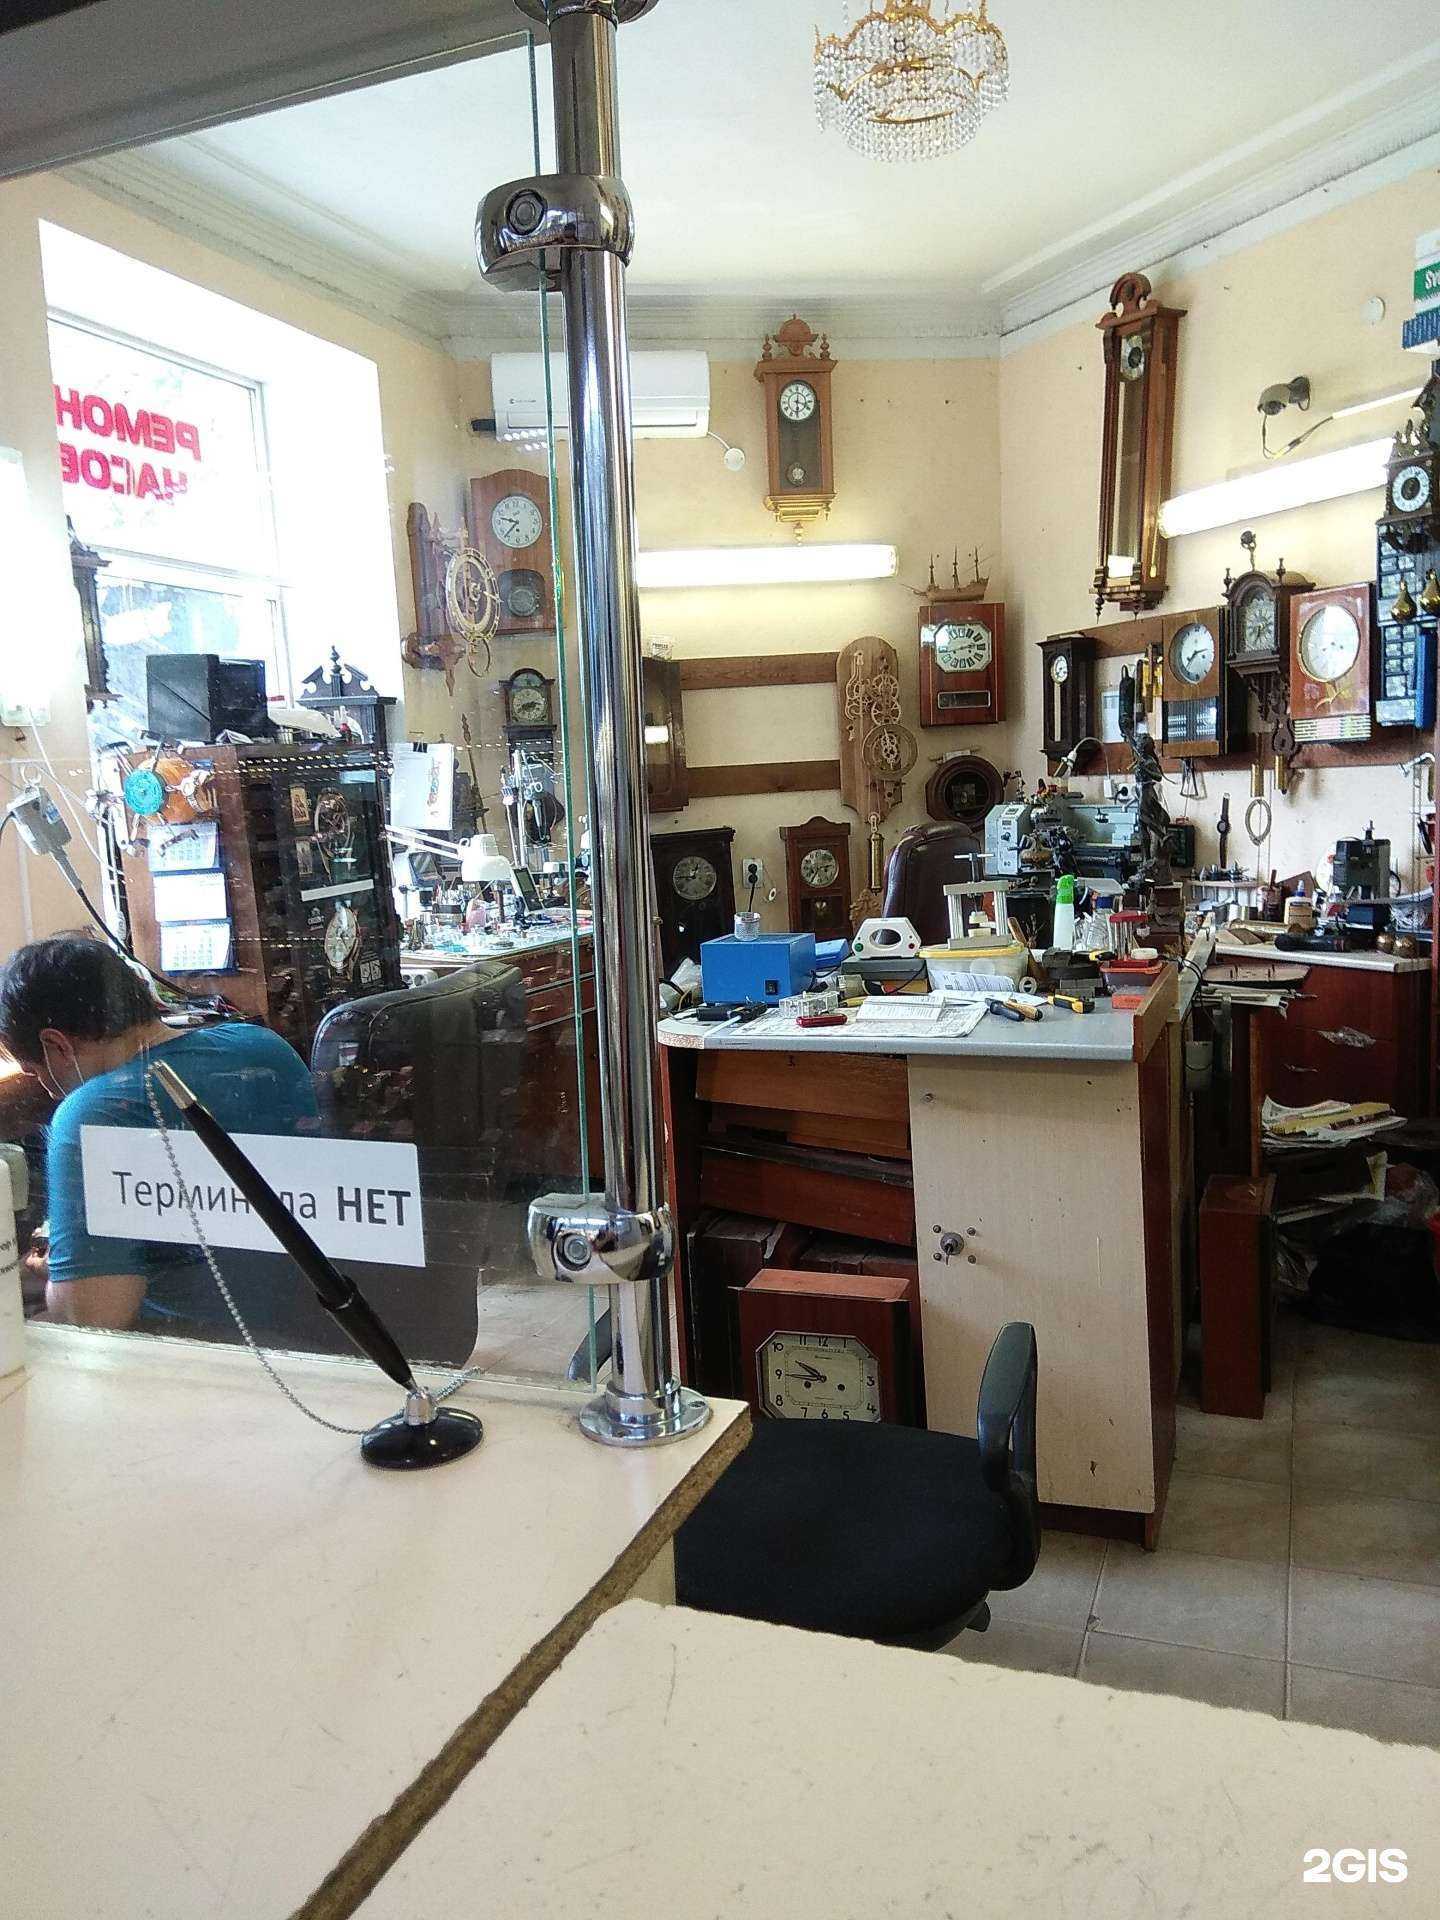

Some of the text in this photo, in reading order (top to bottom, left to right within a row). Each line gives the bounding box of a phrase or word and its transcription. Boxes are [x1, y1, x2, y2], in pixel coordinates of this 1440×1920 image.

[112, 1171, 411, 1226] Терминла НЕТ
[772, 1342, 784, 1352] 10
[775, 1369, 782, 1379] 9
[866, 1376, 875, 1386] 3
[776, 1395, 783, 1407] 8
[801, 1407, 808, 1418] 7
[821, 1409, 829, 1419] 6
